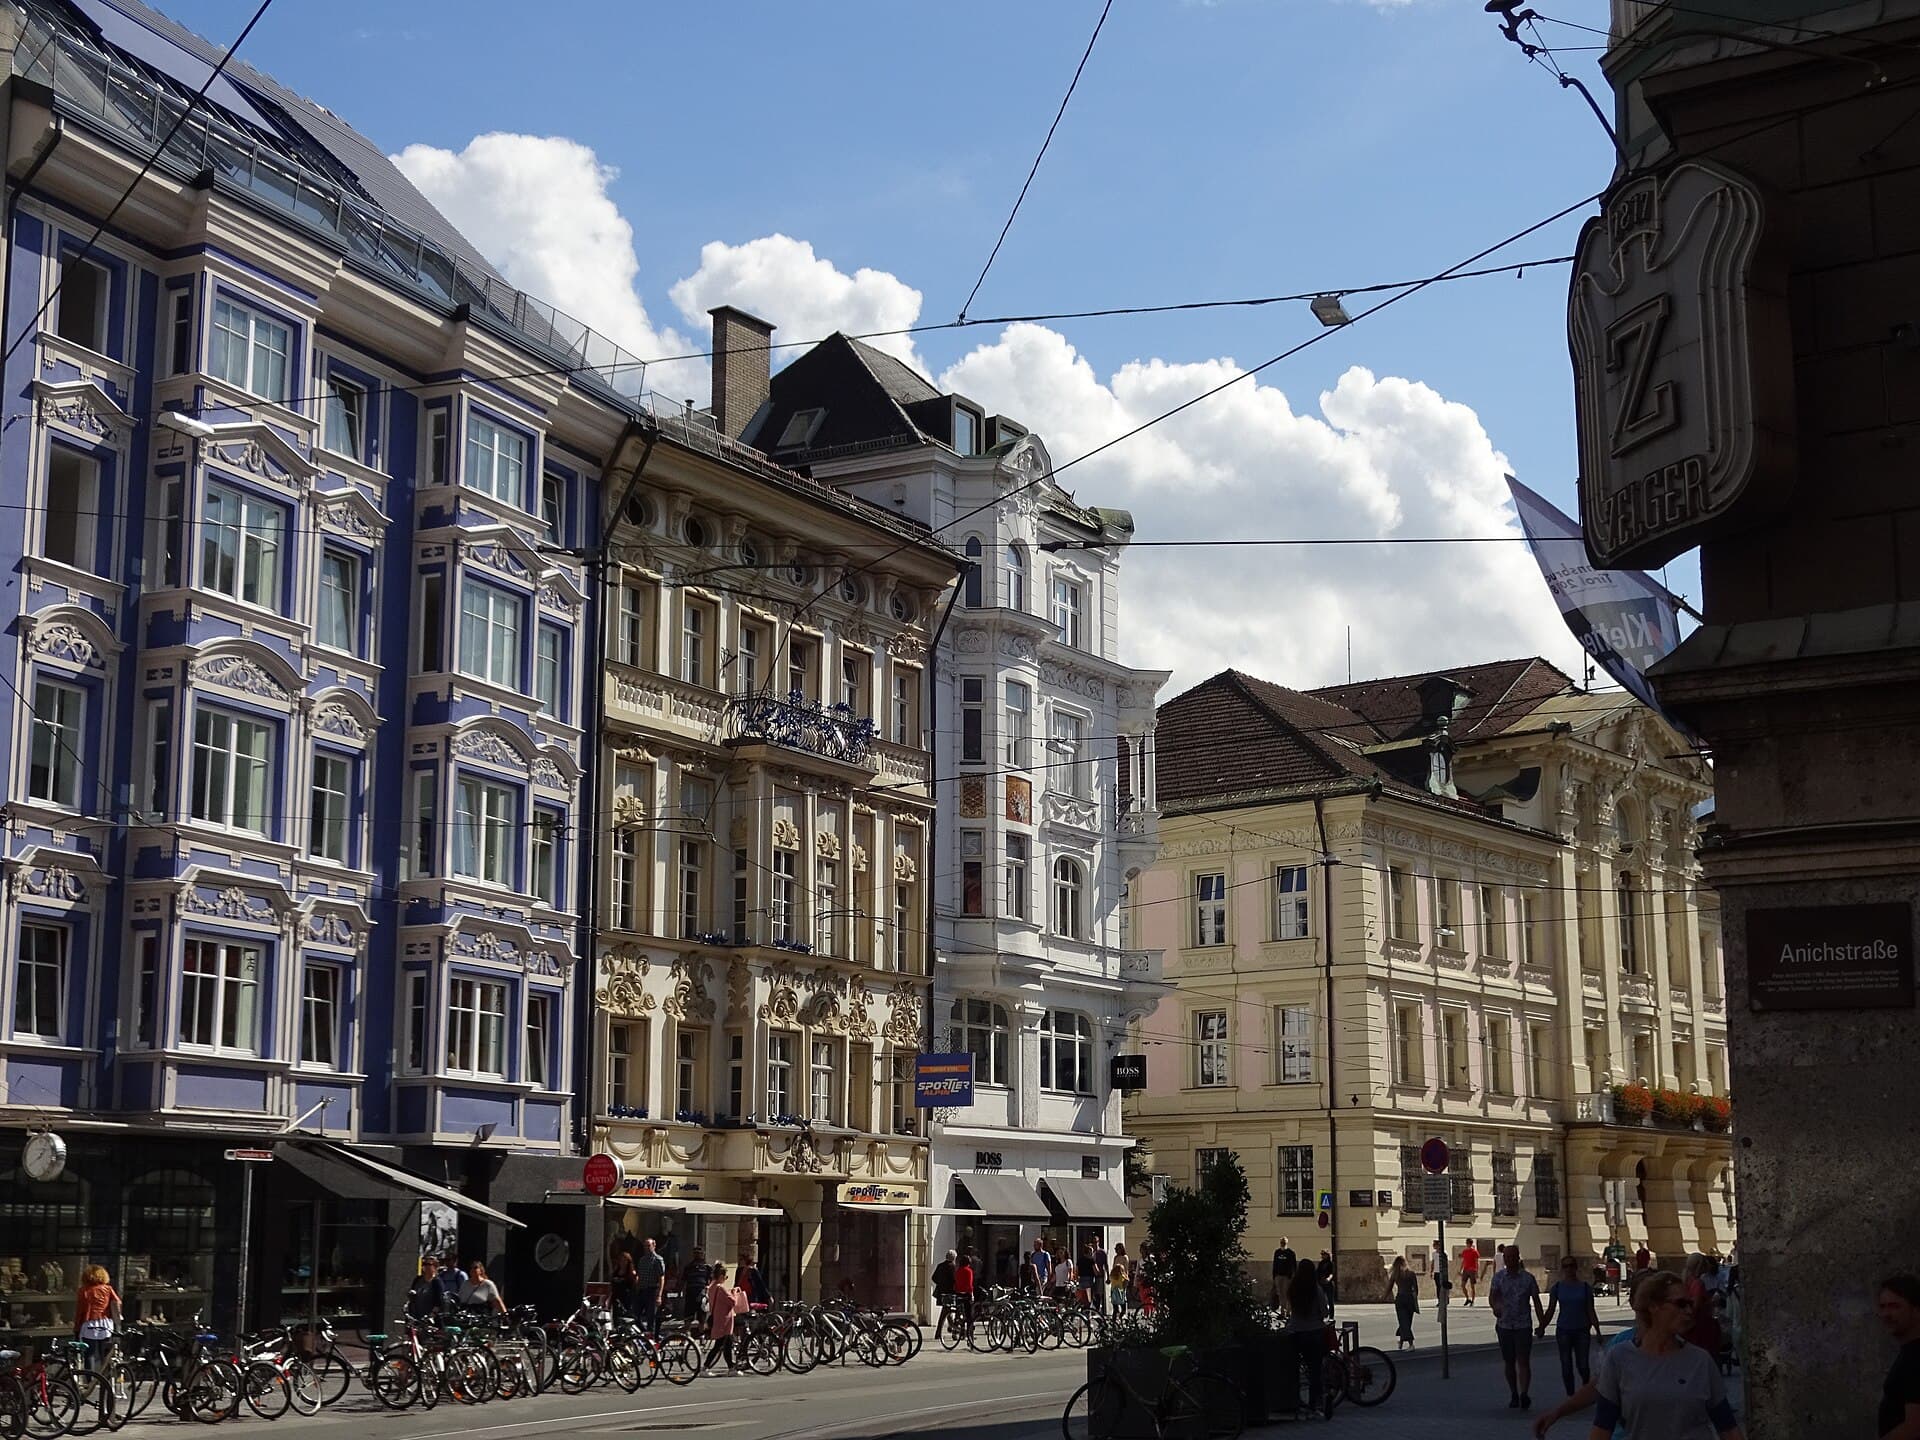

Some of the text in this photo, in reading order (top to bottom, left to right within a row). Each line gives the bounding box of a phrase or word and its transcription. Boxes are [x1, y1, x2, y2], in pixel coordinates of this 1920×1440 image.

[1606, 291, 1682, 458] Z
[1604, 456, 1709, 553] ZELGER
[1779, 939, 1899, 963] Anichstraße
[1116, 1066, 1140, 1075] BOSS
[917, 1078, 970, 1093] SPORTLER
[976, 1151, 1002, 1166] BOSS
[622, 1175, 672, 1194] SPORTLER
[847, 1184, 888, 1200] SPORTLER
